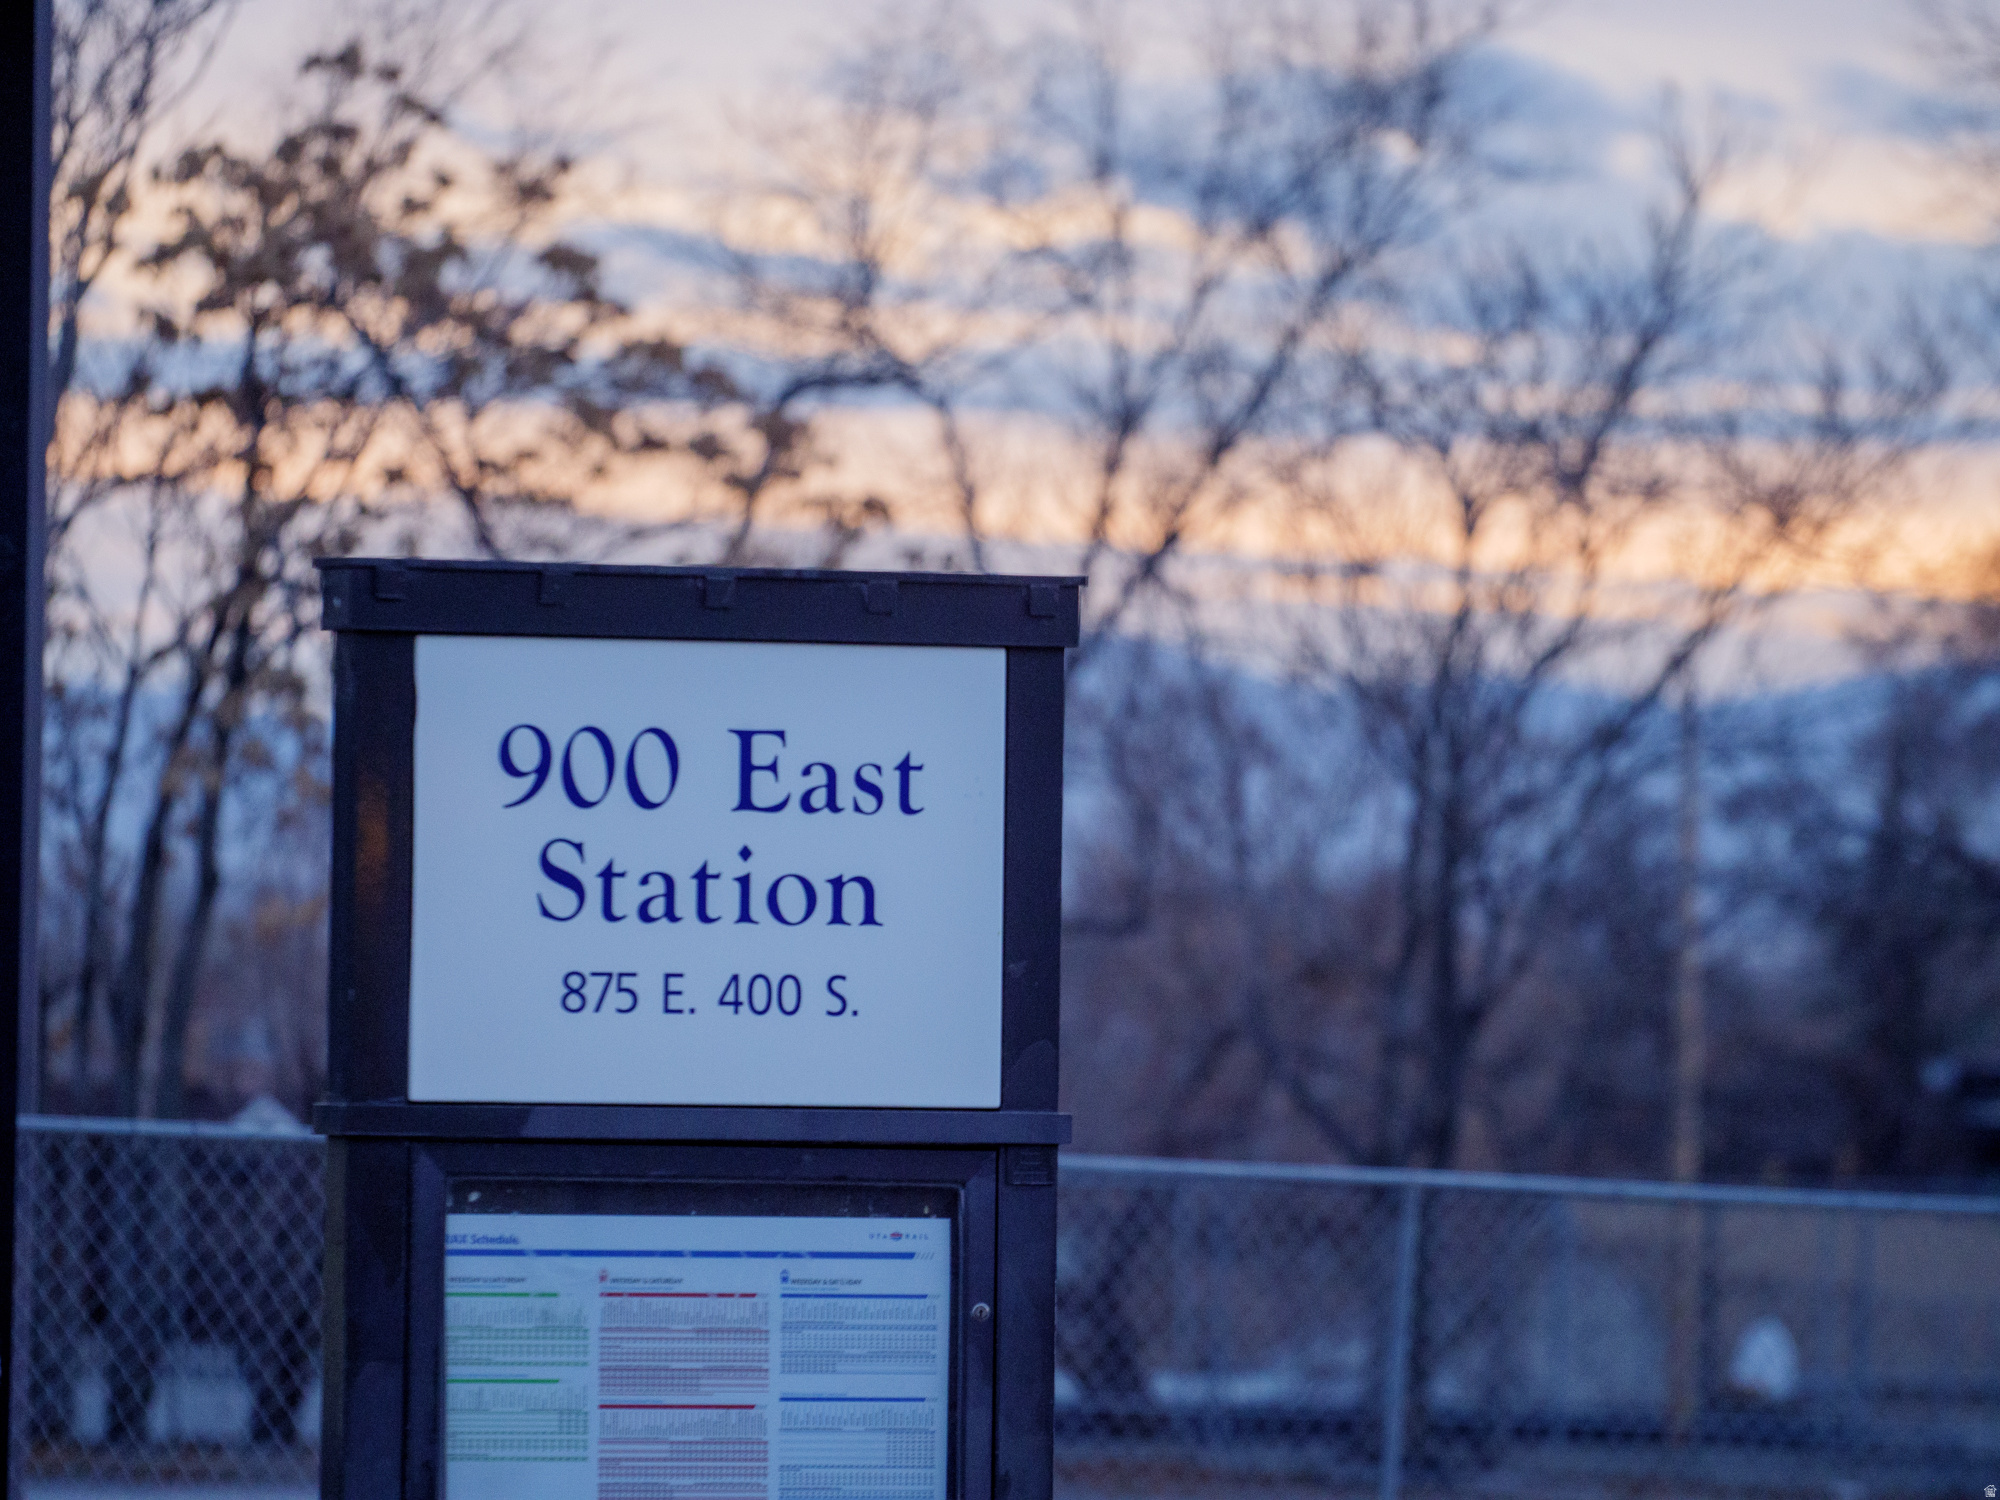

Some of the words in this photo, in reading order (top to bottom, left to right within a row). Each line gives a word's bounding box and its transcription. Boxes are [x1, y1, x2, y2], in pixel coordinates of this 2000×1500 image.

[497, 723, 681, 811] 900
[727, 728, 925, 817] East
[536, 837, 884, 928] Station
[560, 970, 639, 1016] 875
[662, 972, 697, 1016] E.
[717, 973, 803, 1018] 400
[825, 974, 860, 1019] S.
